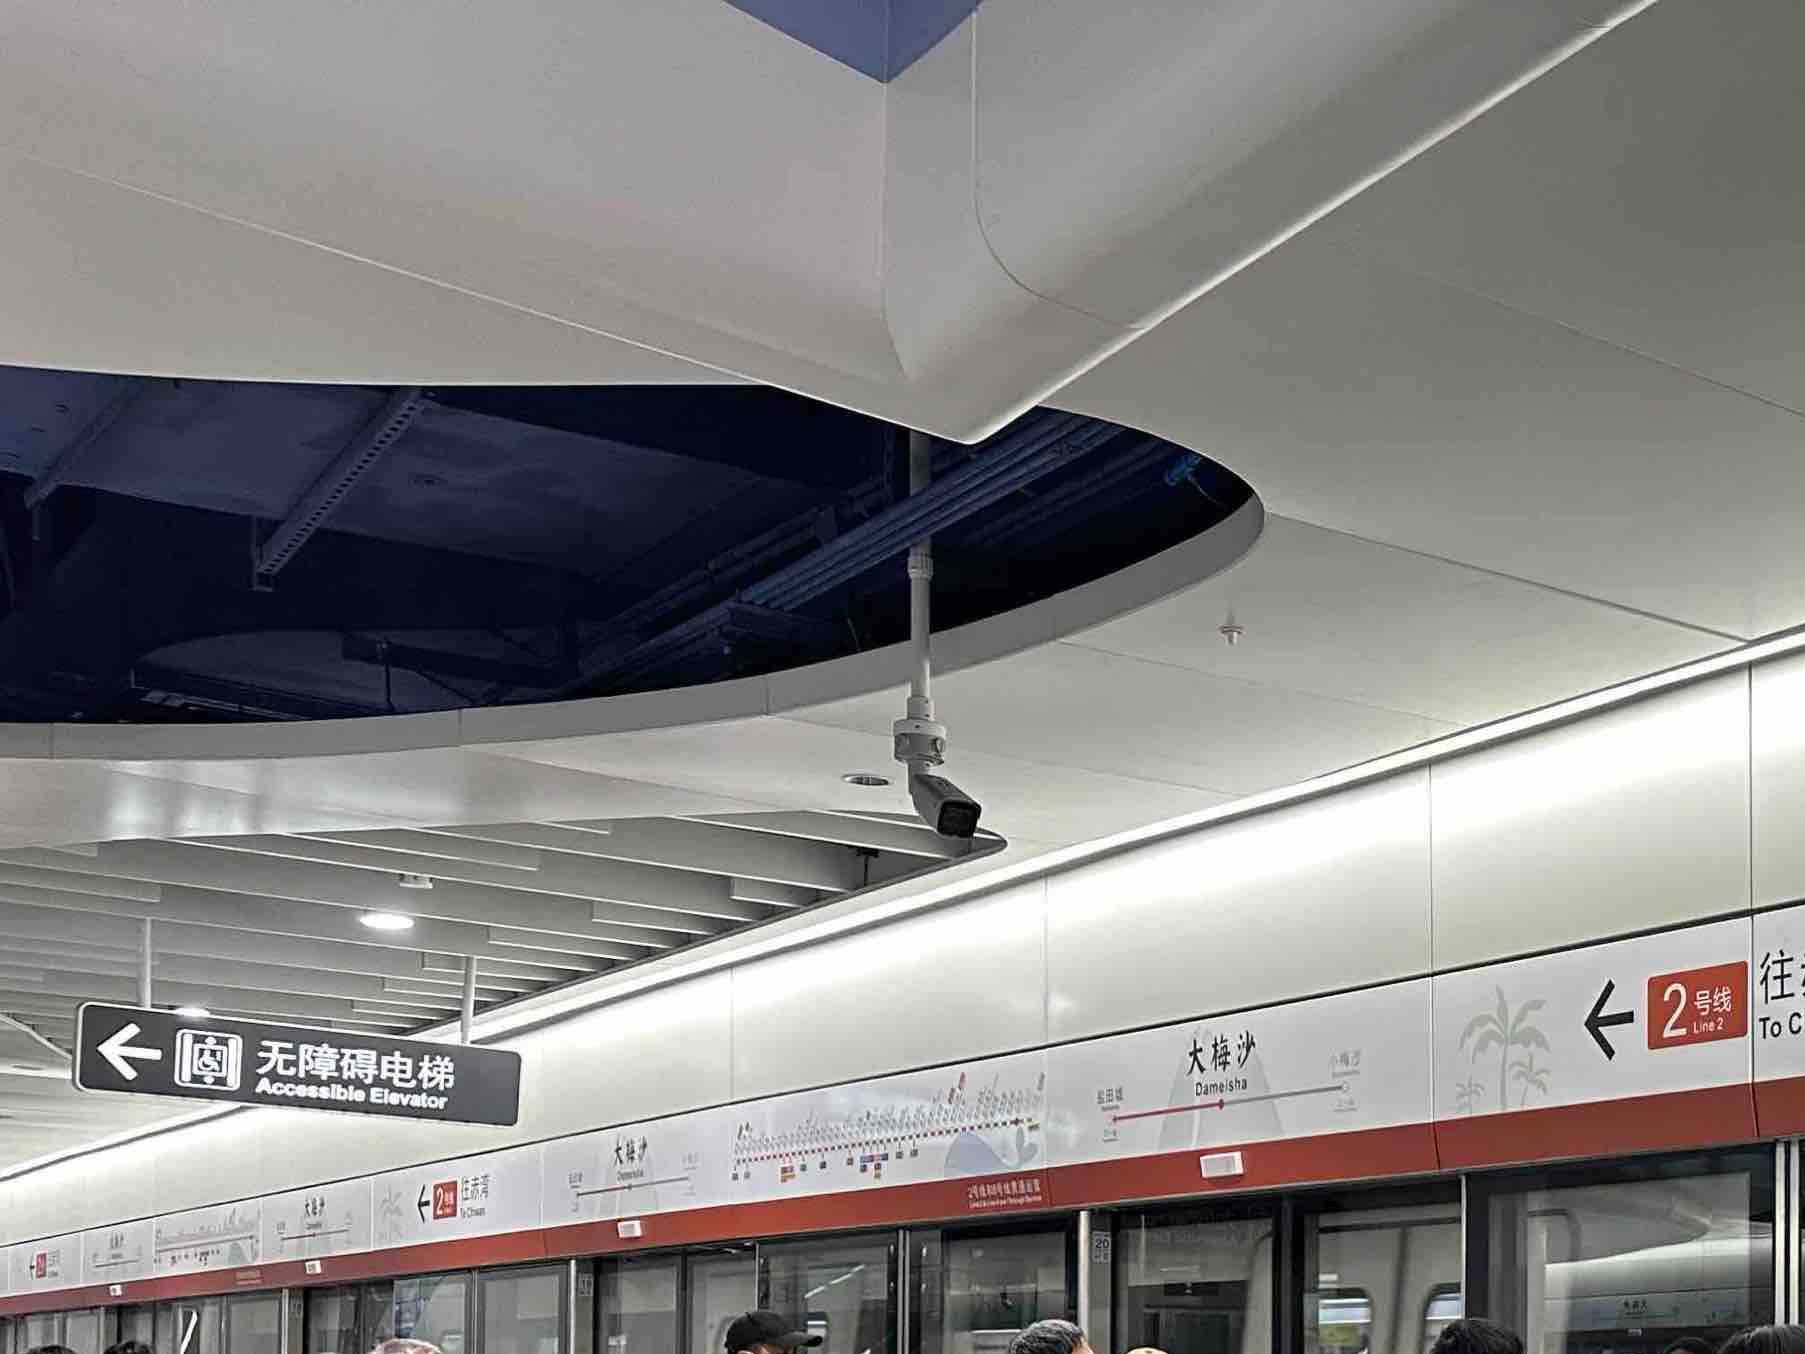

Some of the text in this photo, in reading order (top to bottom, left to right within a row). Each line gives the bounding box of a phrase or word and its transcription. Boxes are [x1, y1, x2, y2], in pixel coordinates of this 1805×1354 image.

[1692, 1017, 1724, 1035] Line 2
[1758, 1017, 1782, 1040] To
[255, 1040, 455, 1091] 无障碍电梯
[1186, 1029, 1256, 1077] 大梅沙
[255, 1077, 449, 1109] Accessible Elevator
[1195, 1076, 1247, 1097] Dameisha
